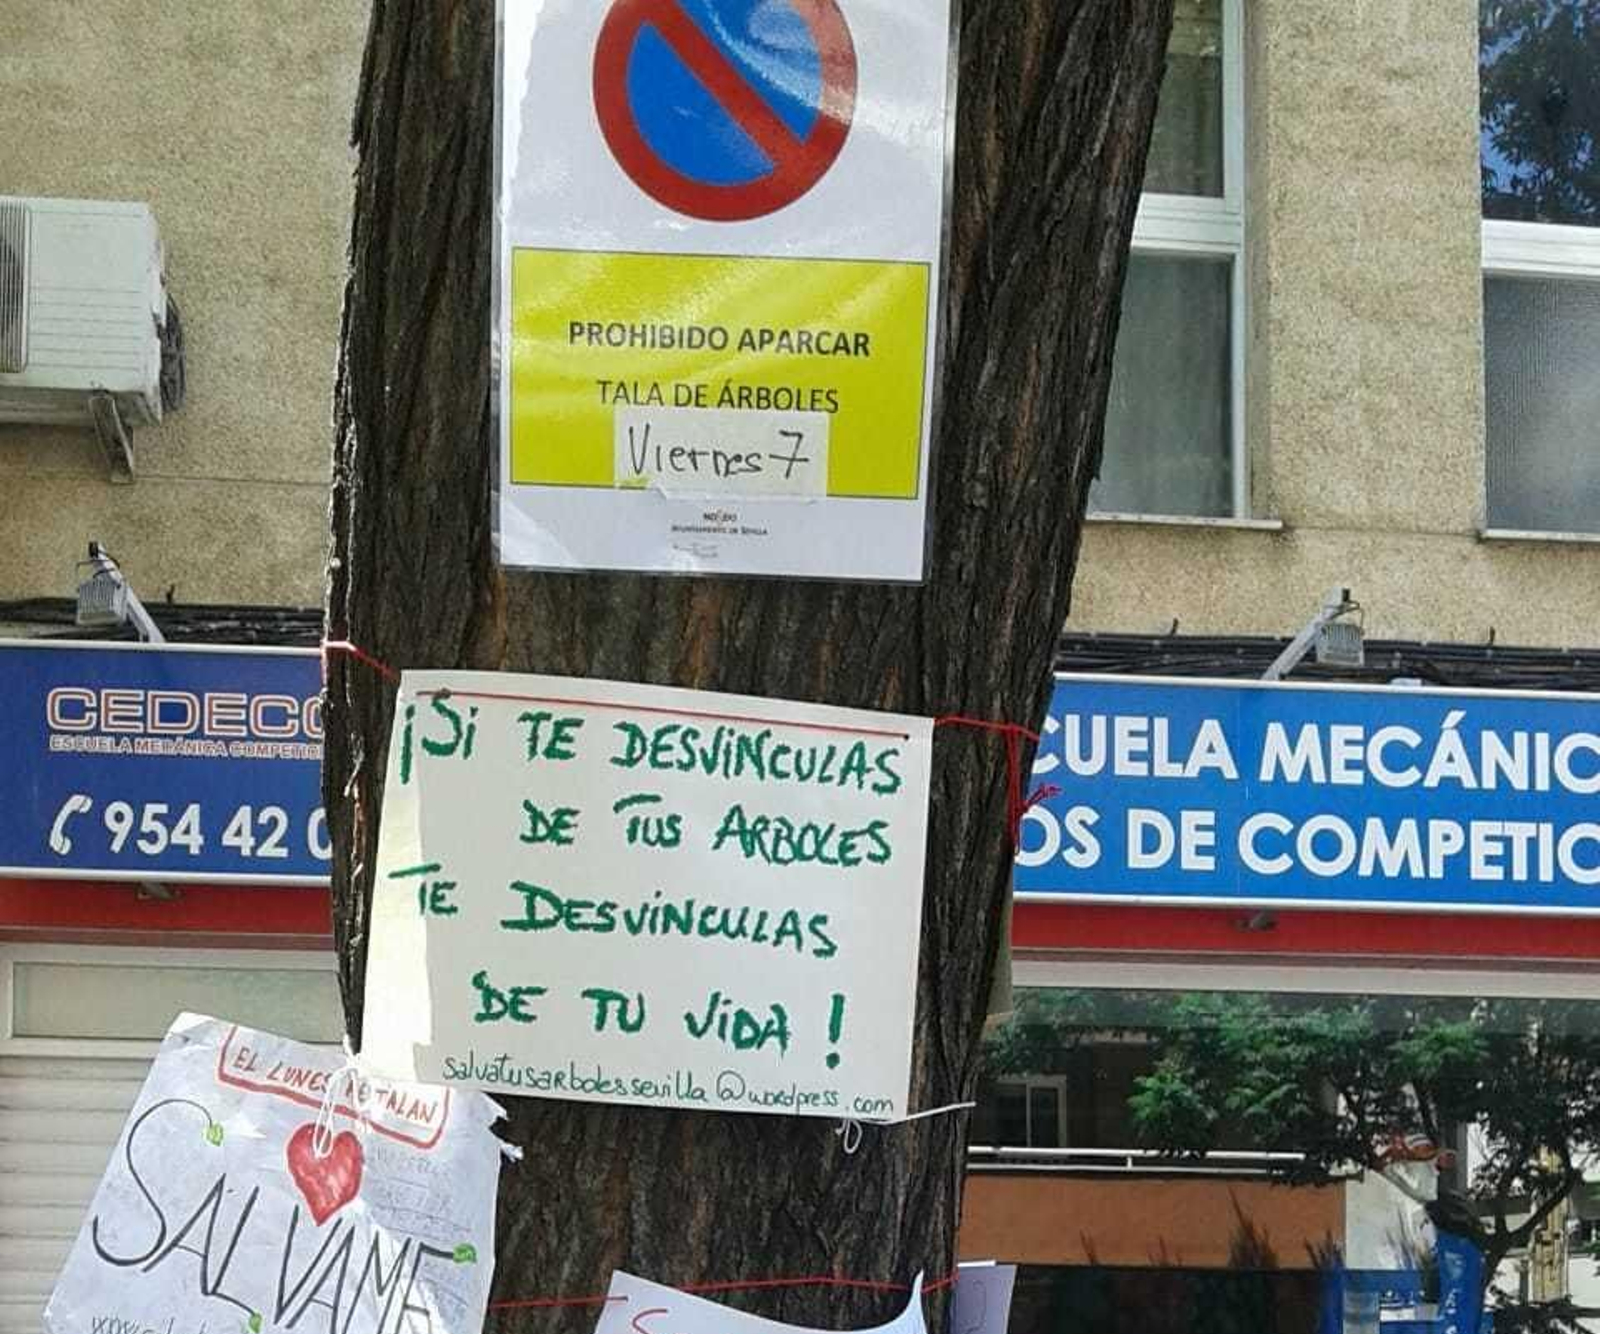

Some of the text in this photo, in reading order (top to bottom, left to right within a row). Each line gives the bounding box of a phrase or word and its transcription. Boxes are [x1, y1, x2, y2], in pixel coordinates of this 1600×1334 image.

[568, 320, 871, 357] PROHIBIDO APARCAR
[596, 378, 840, 414] TALA DE ÁRBOLES
[769, 430, 810, 479] 7
[50, 734, 134, 753] ESCUELA
[518, 711, 583, 761] TE
[1259, 710, 1600, 794] MECÁNIC
[104, 801, 204, 855] 954
[221, 805, 289, 858] 42
[520, 794, 892, 867] DE TUS ARBOLES
[1127, 809, 1216, 871] DE
[1237, 812, 1600, 884] COMPETIC
[389, 863, 458, 916] TE
[472, 971, 547, 1023] DE
[582, 987, 645, 1033] TU
[233, 1046, 257, 1073] EL
